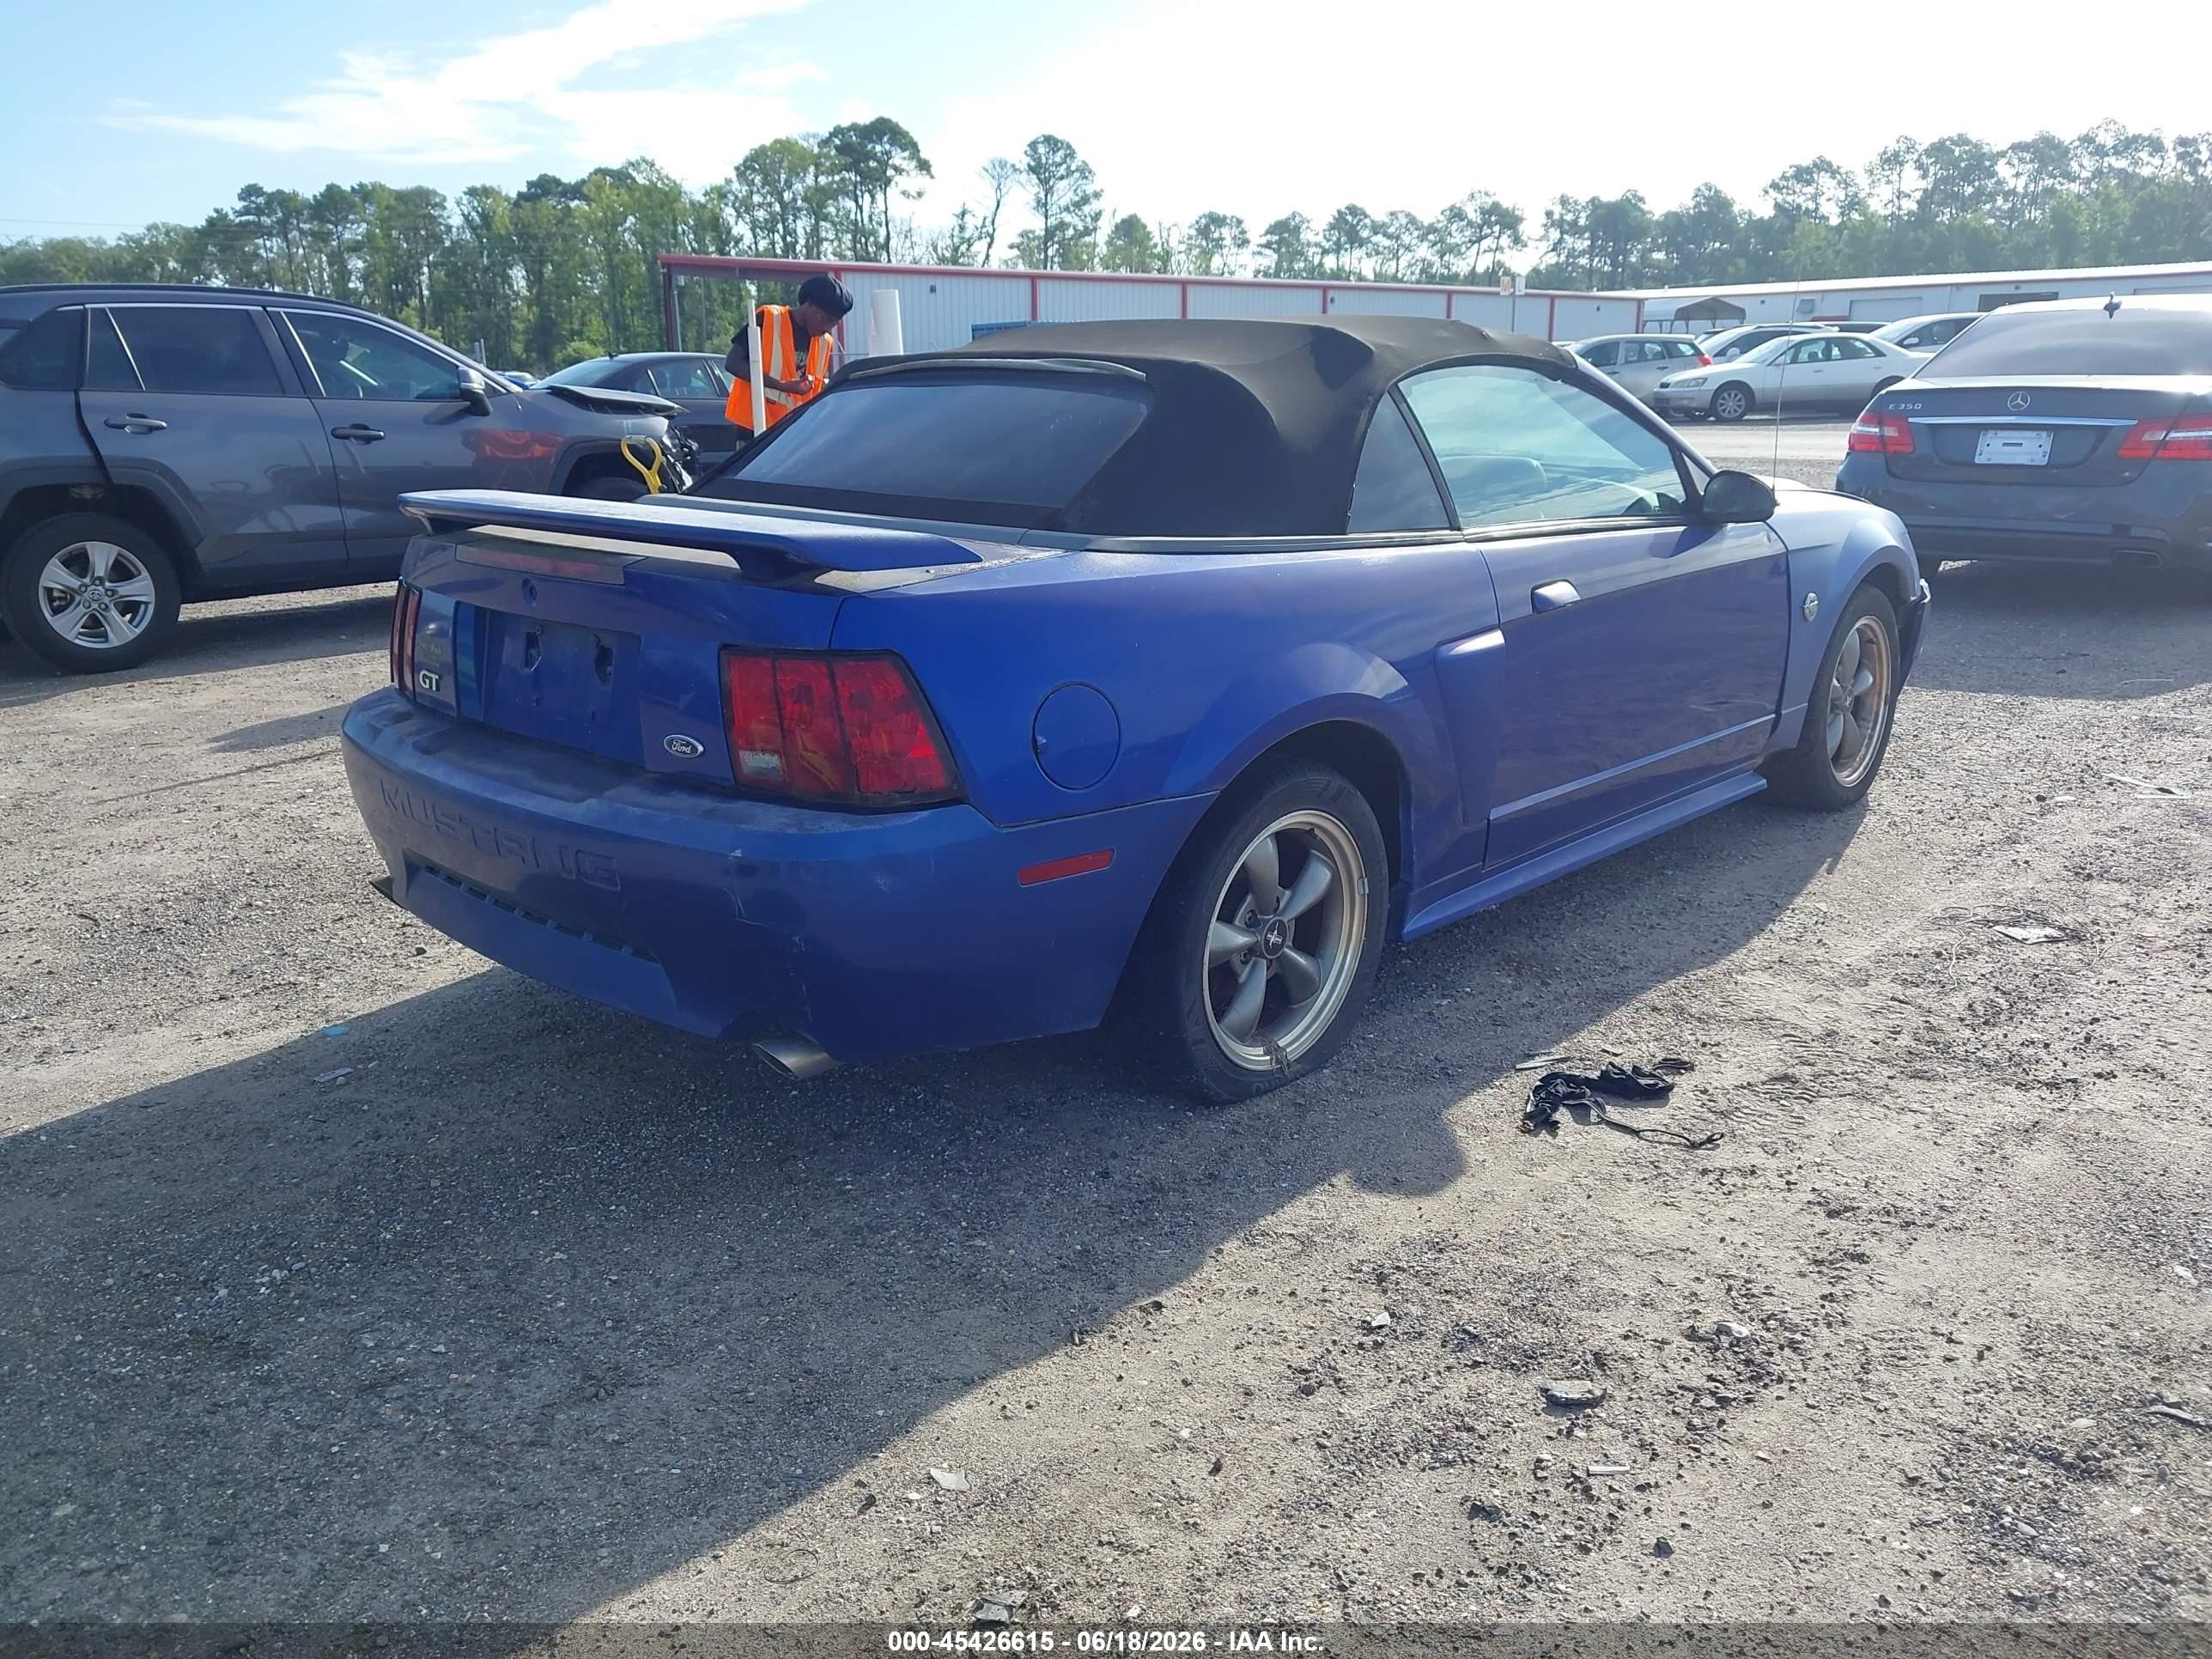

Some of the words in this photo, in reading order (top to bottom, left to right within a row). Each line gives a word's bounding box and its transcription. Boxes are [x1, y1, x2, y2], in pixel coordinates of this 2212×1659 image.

[419, 670, 440, 691] GT
[672, 738, 692, 754] Ford
[380, 778, 622, 892] MUSTANG
